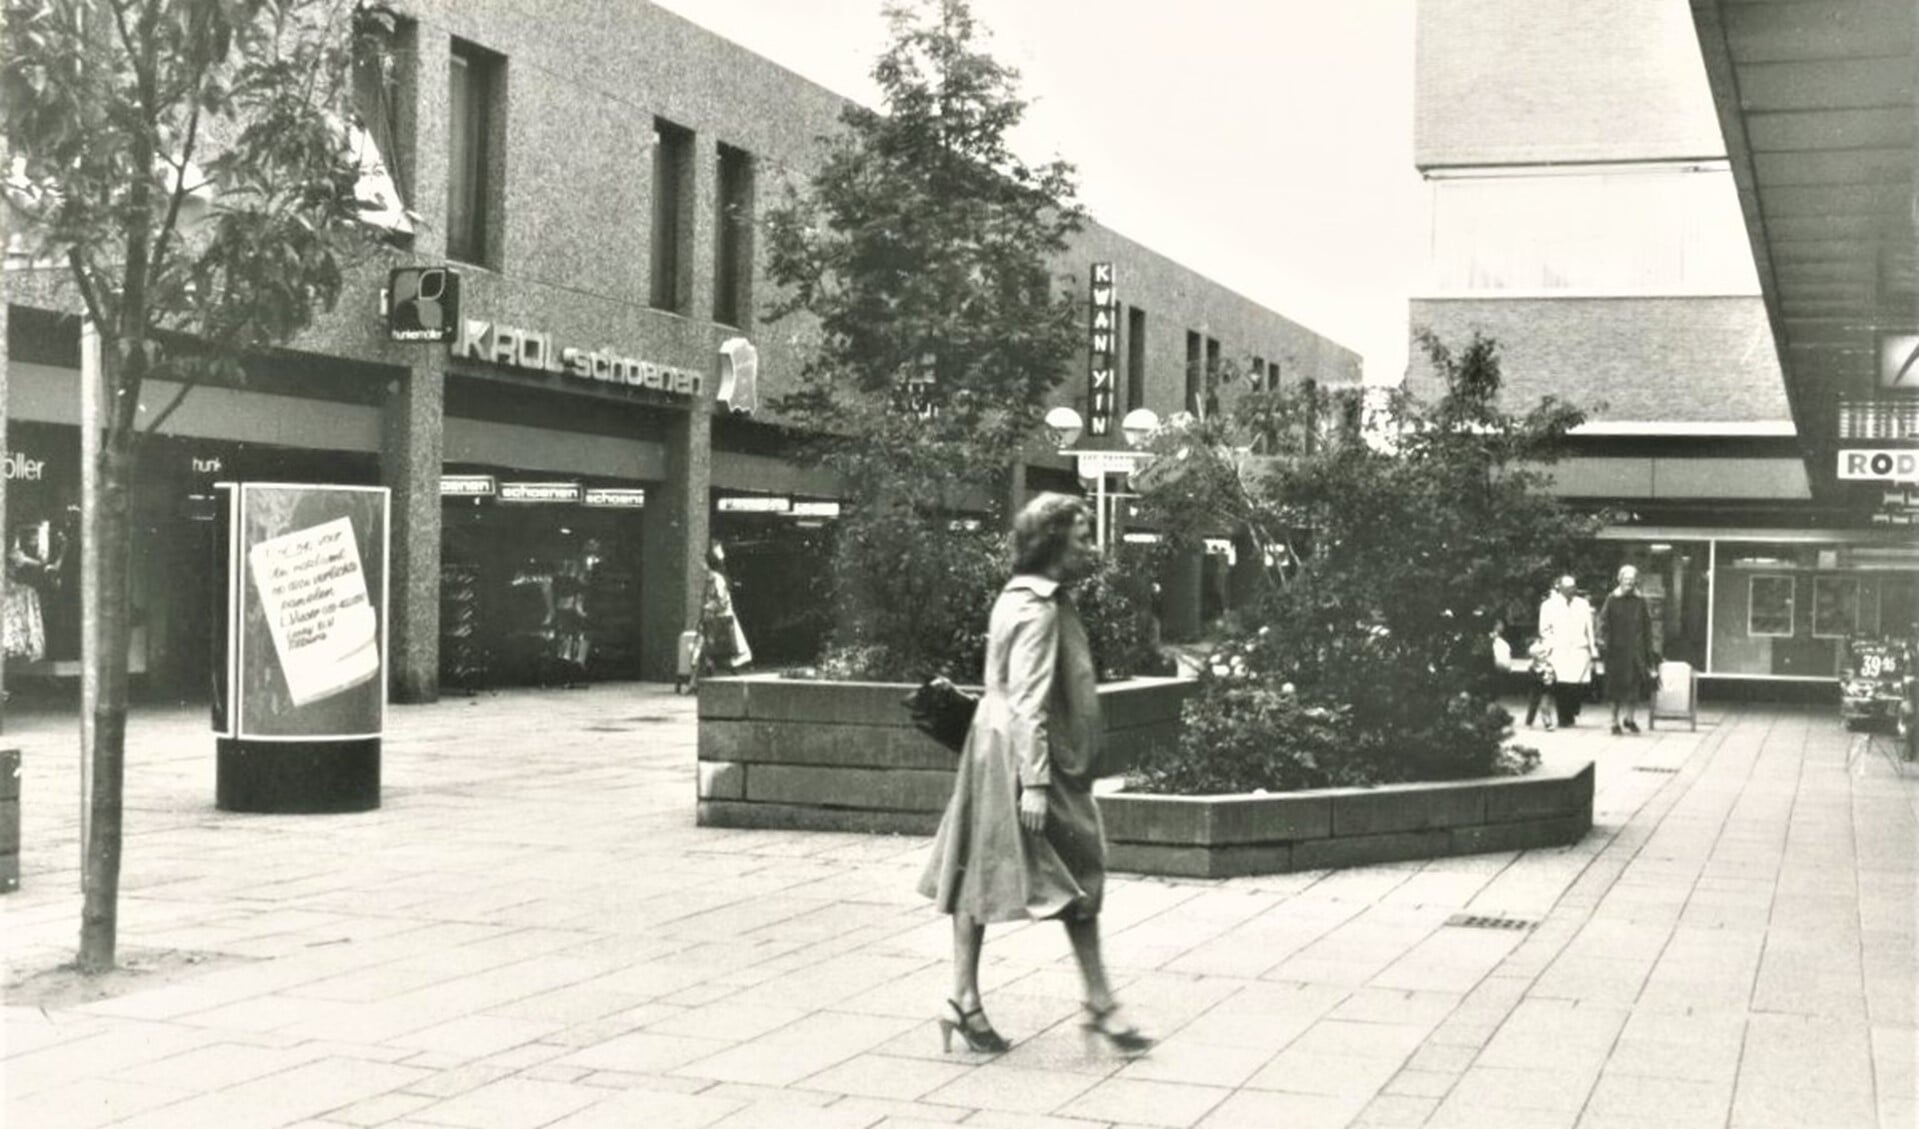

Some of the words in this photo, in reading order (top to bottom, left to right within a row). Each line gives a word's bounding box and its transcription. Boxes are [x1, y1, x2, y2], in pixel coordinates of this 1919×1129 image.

[1093, 264, 1110, 352] KWAN
[459, 318, 565, 374] KROL
[1092, 369, 1107, 434] YIN
[1848, 453, 1915, 475] ROD
[502, 485, 577, 500] schoenen
